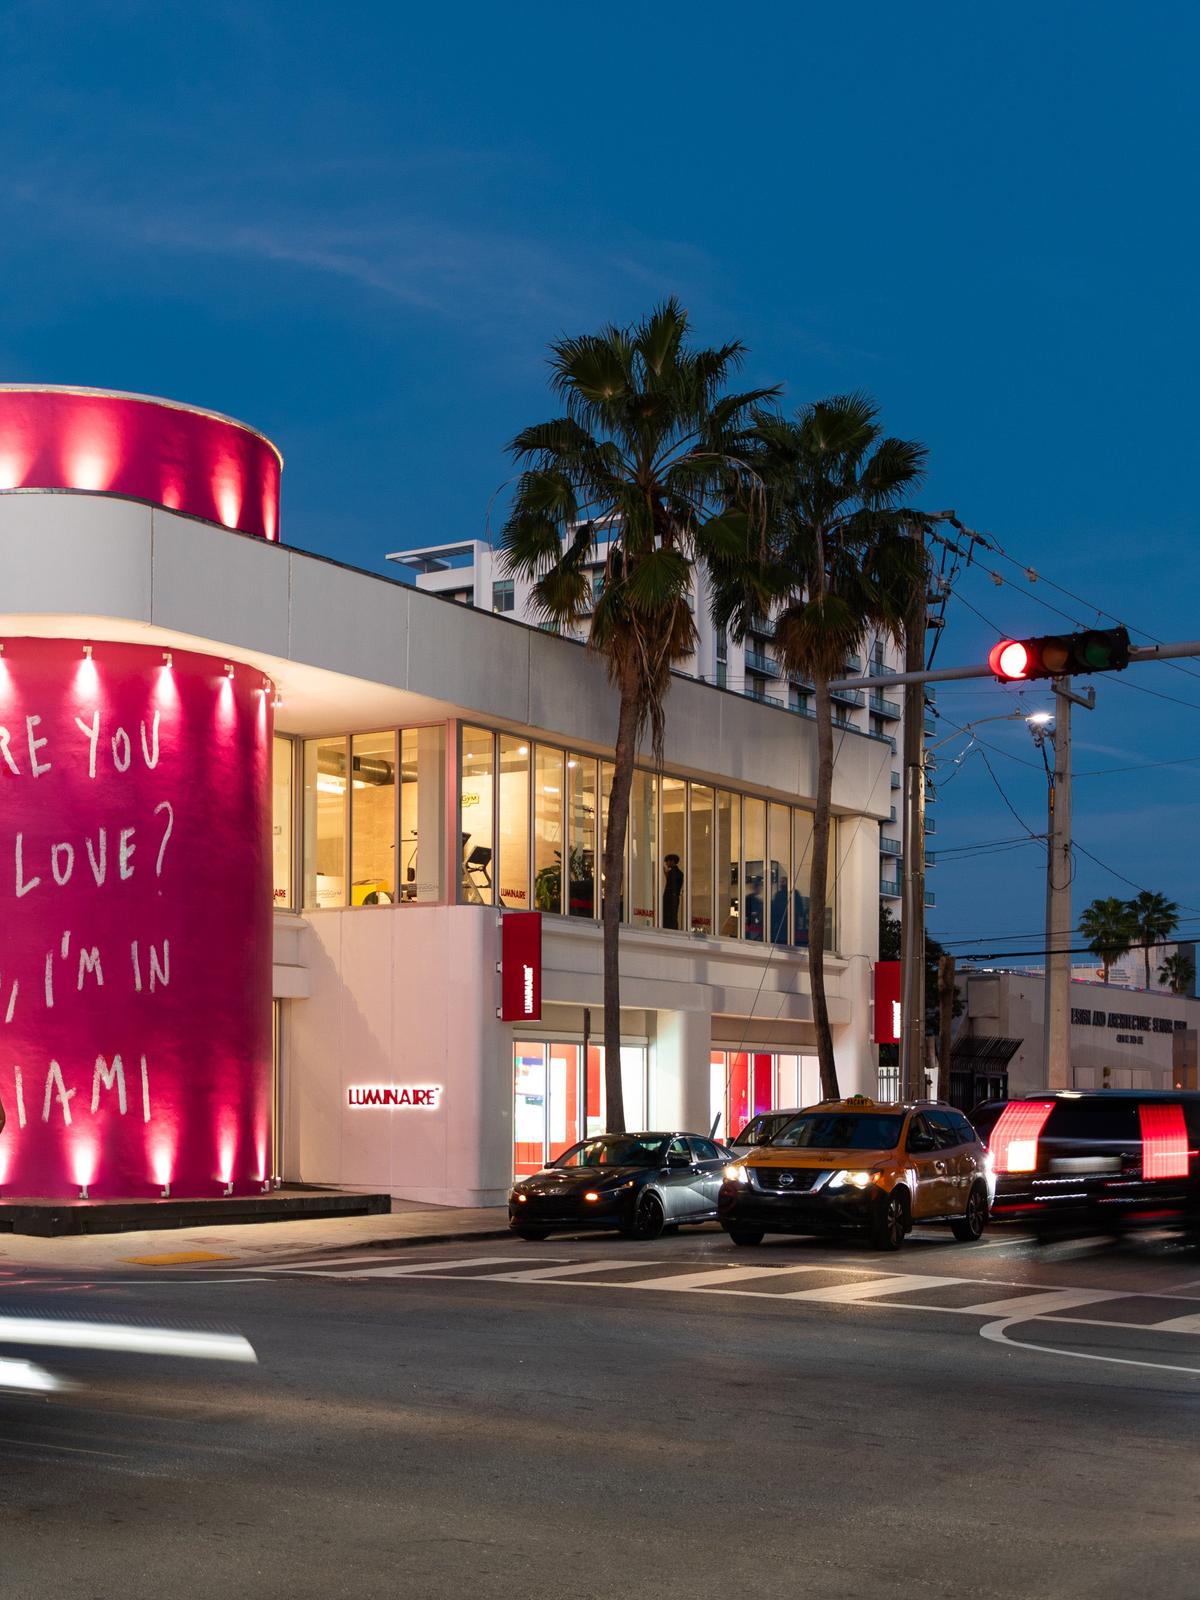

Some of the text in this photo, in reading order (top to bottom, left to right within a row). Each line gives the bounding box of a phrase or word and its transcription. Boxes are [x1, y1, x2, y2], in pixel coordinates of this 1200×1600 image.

[74, 710, 160, 778] YOU
[15, 801, 174, 897] LOVE?
[500, 887, 526, 899] LUMINAIRE
[44, 930, 104, 1008] I'M
[130, 938, 170, 993] IN
[348, 1088, 436, 1105] LUMINAIRE
